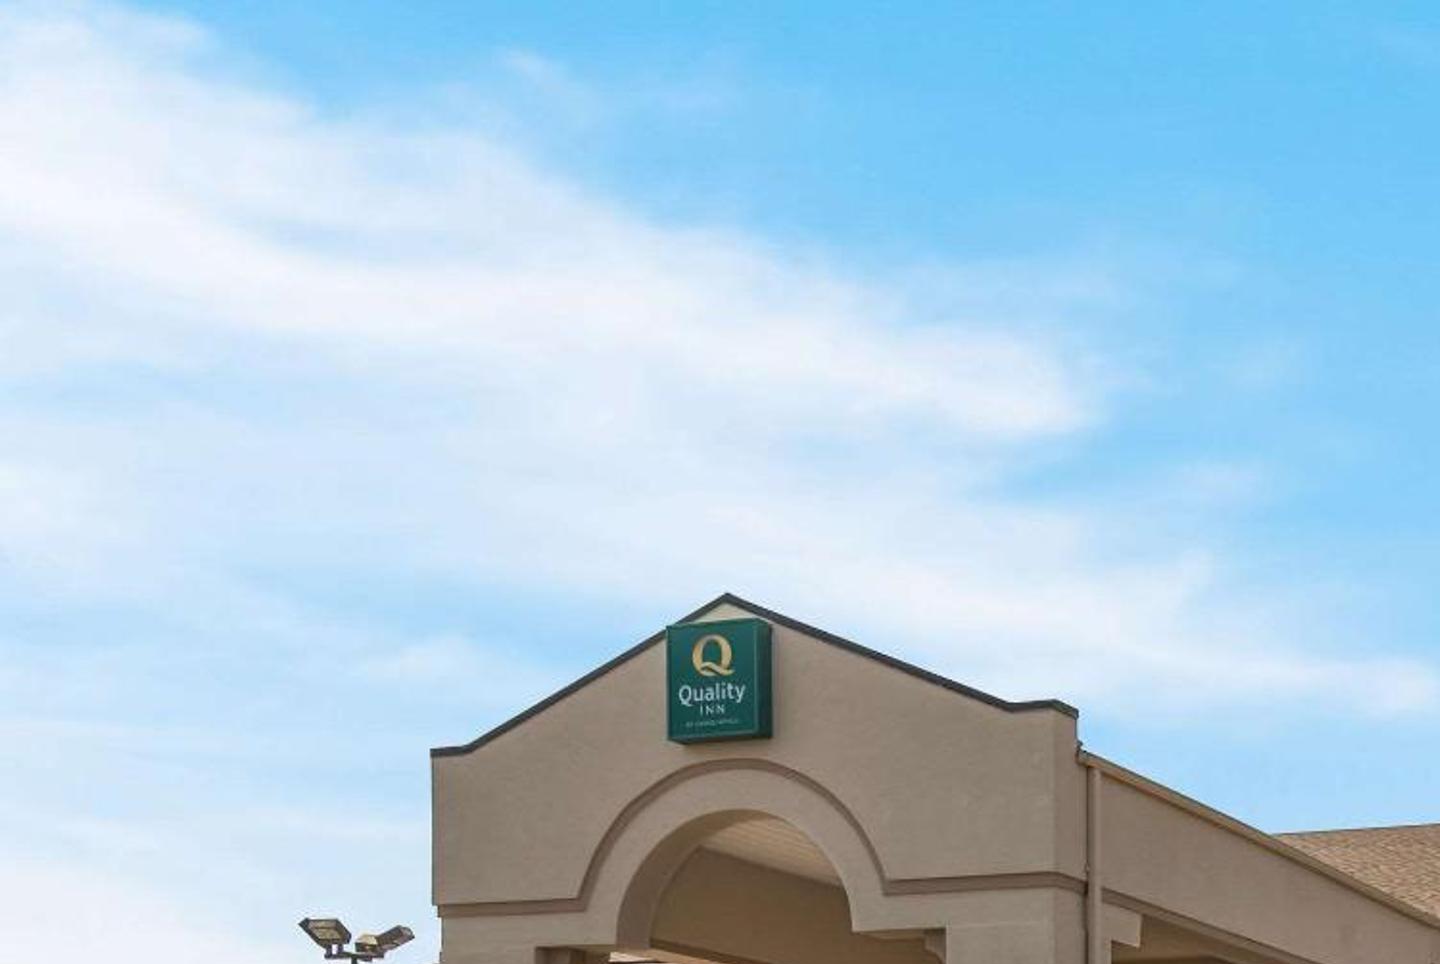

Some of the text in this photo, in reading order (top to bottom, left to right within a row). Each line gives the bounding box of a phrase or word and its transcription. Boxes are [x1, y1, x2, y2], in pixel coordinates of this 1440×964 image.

[692, 634, 735, 677] Q
[678, 682, 746, 707] Quality
[700, 704, 725, 716] INN
